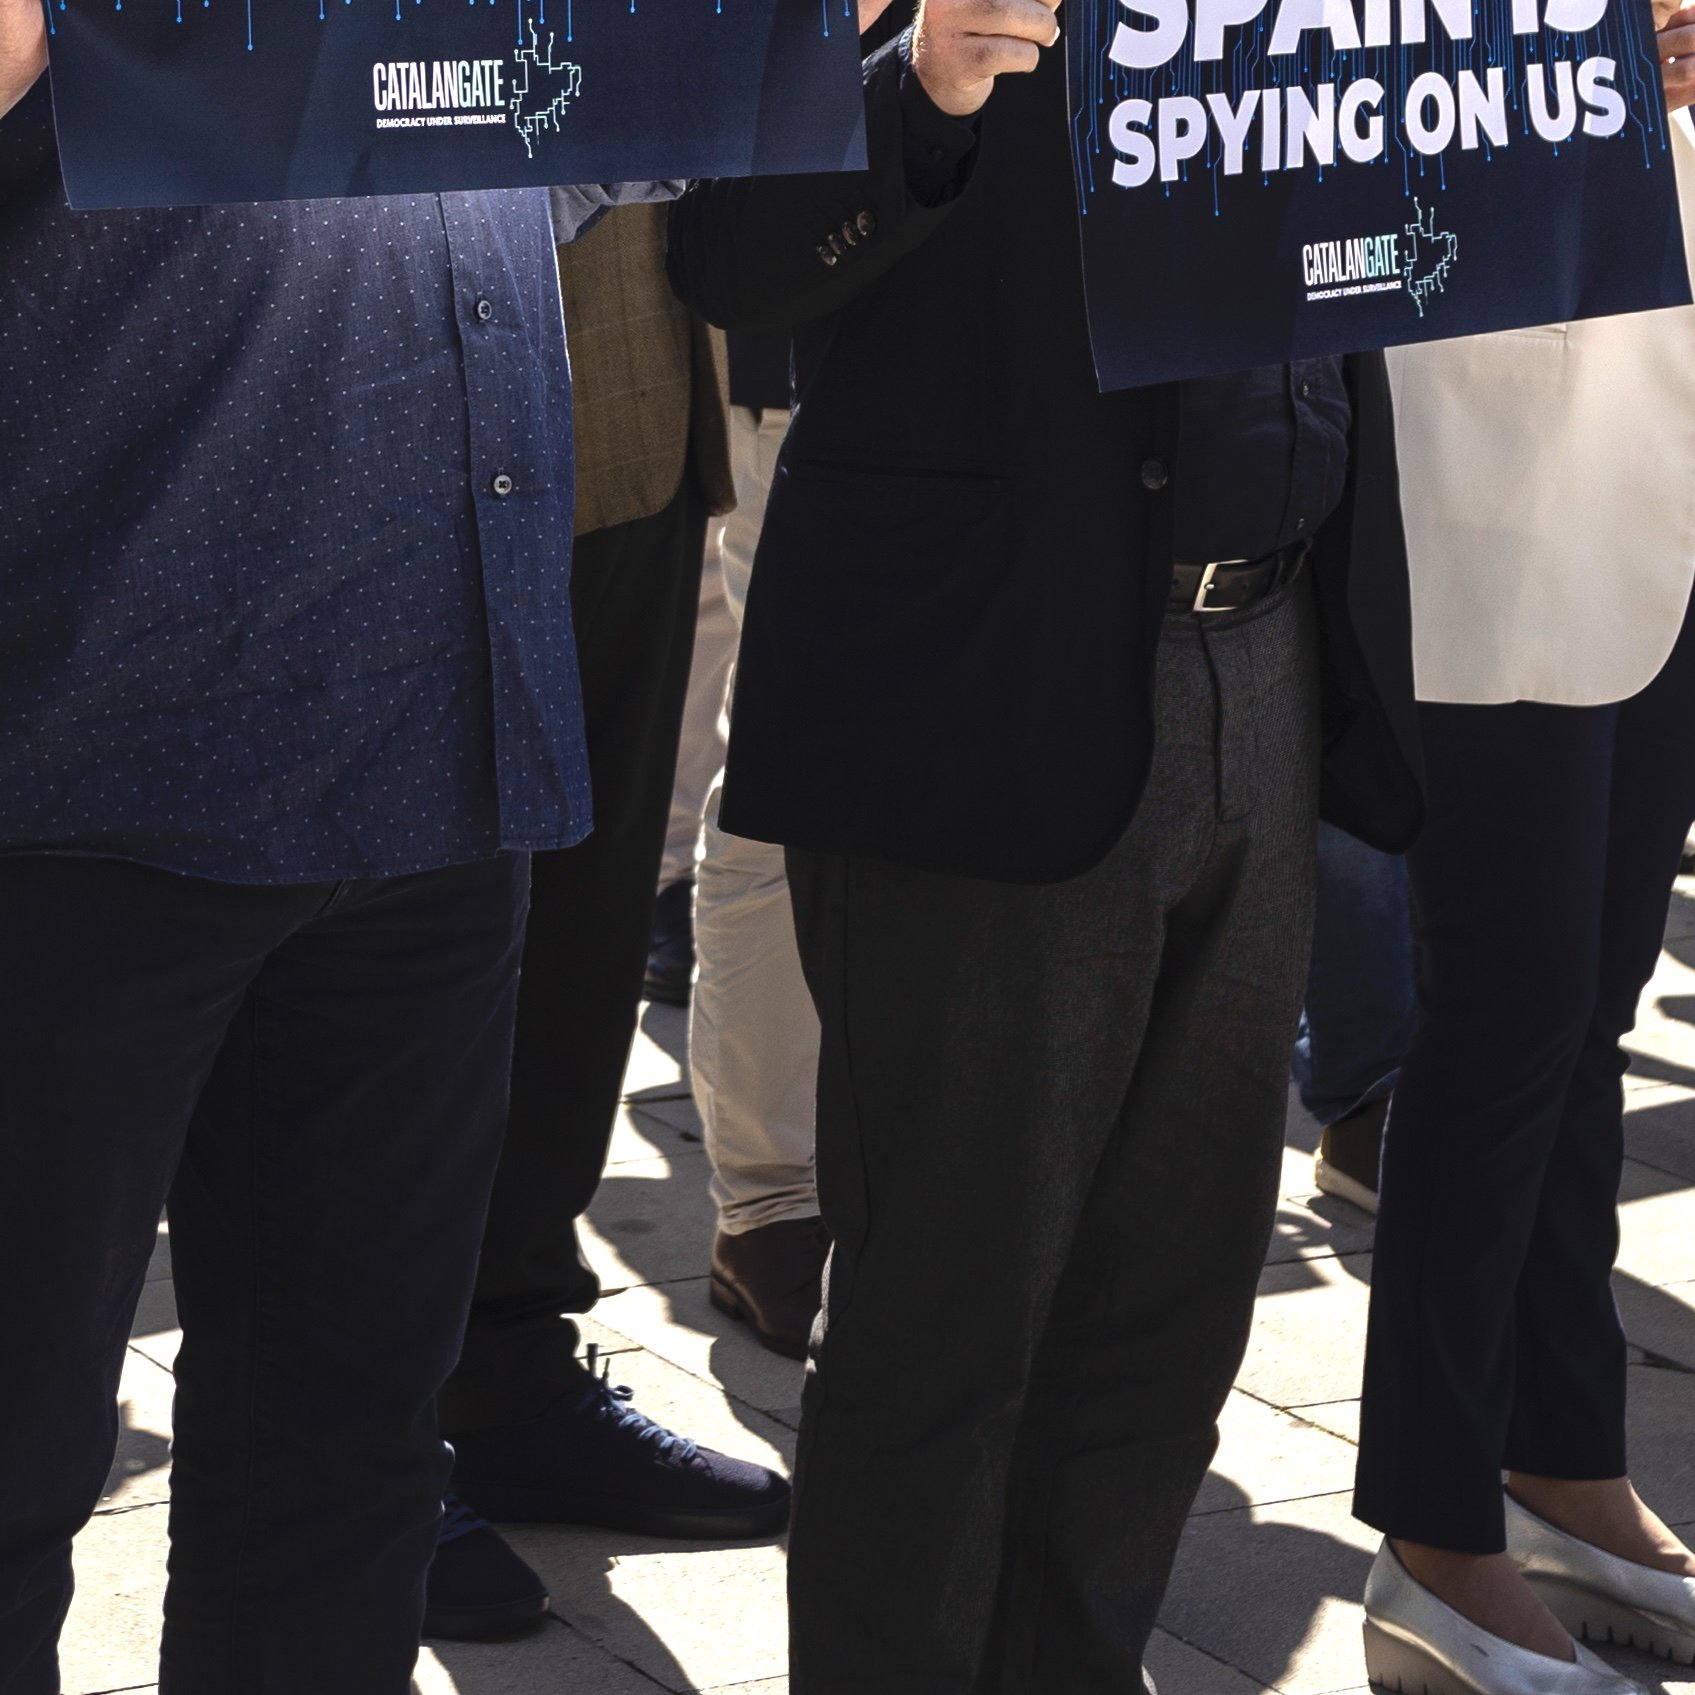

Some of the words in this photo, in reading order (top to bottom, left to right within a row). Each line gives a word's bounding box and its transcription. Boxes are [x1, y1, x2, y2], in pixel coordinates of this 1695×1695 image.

[373, 59, 506, 111] CATALANGATE
[376, 116, 425, 129] DEMOCRACY
[426, 115, 453, 127] UNDER
[453, 113, 506, 126] SURVEILLANCE
[1108, 77, 1386, 188] SPYING
[1404, 70, 1510, 156] ON
[1527, 57, 1627, 144] US
[1302, 233, 1401, 287] CATALANGATE
